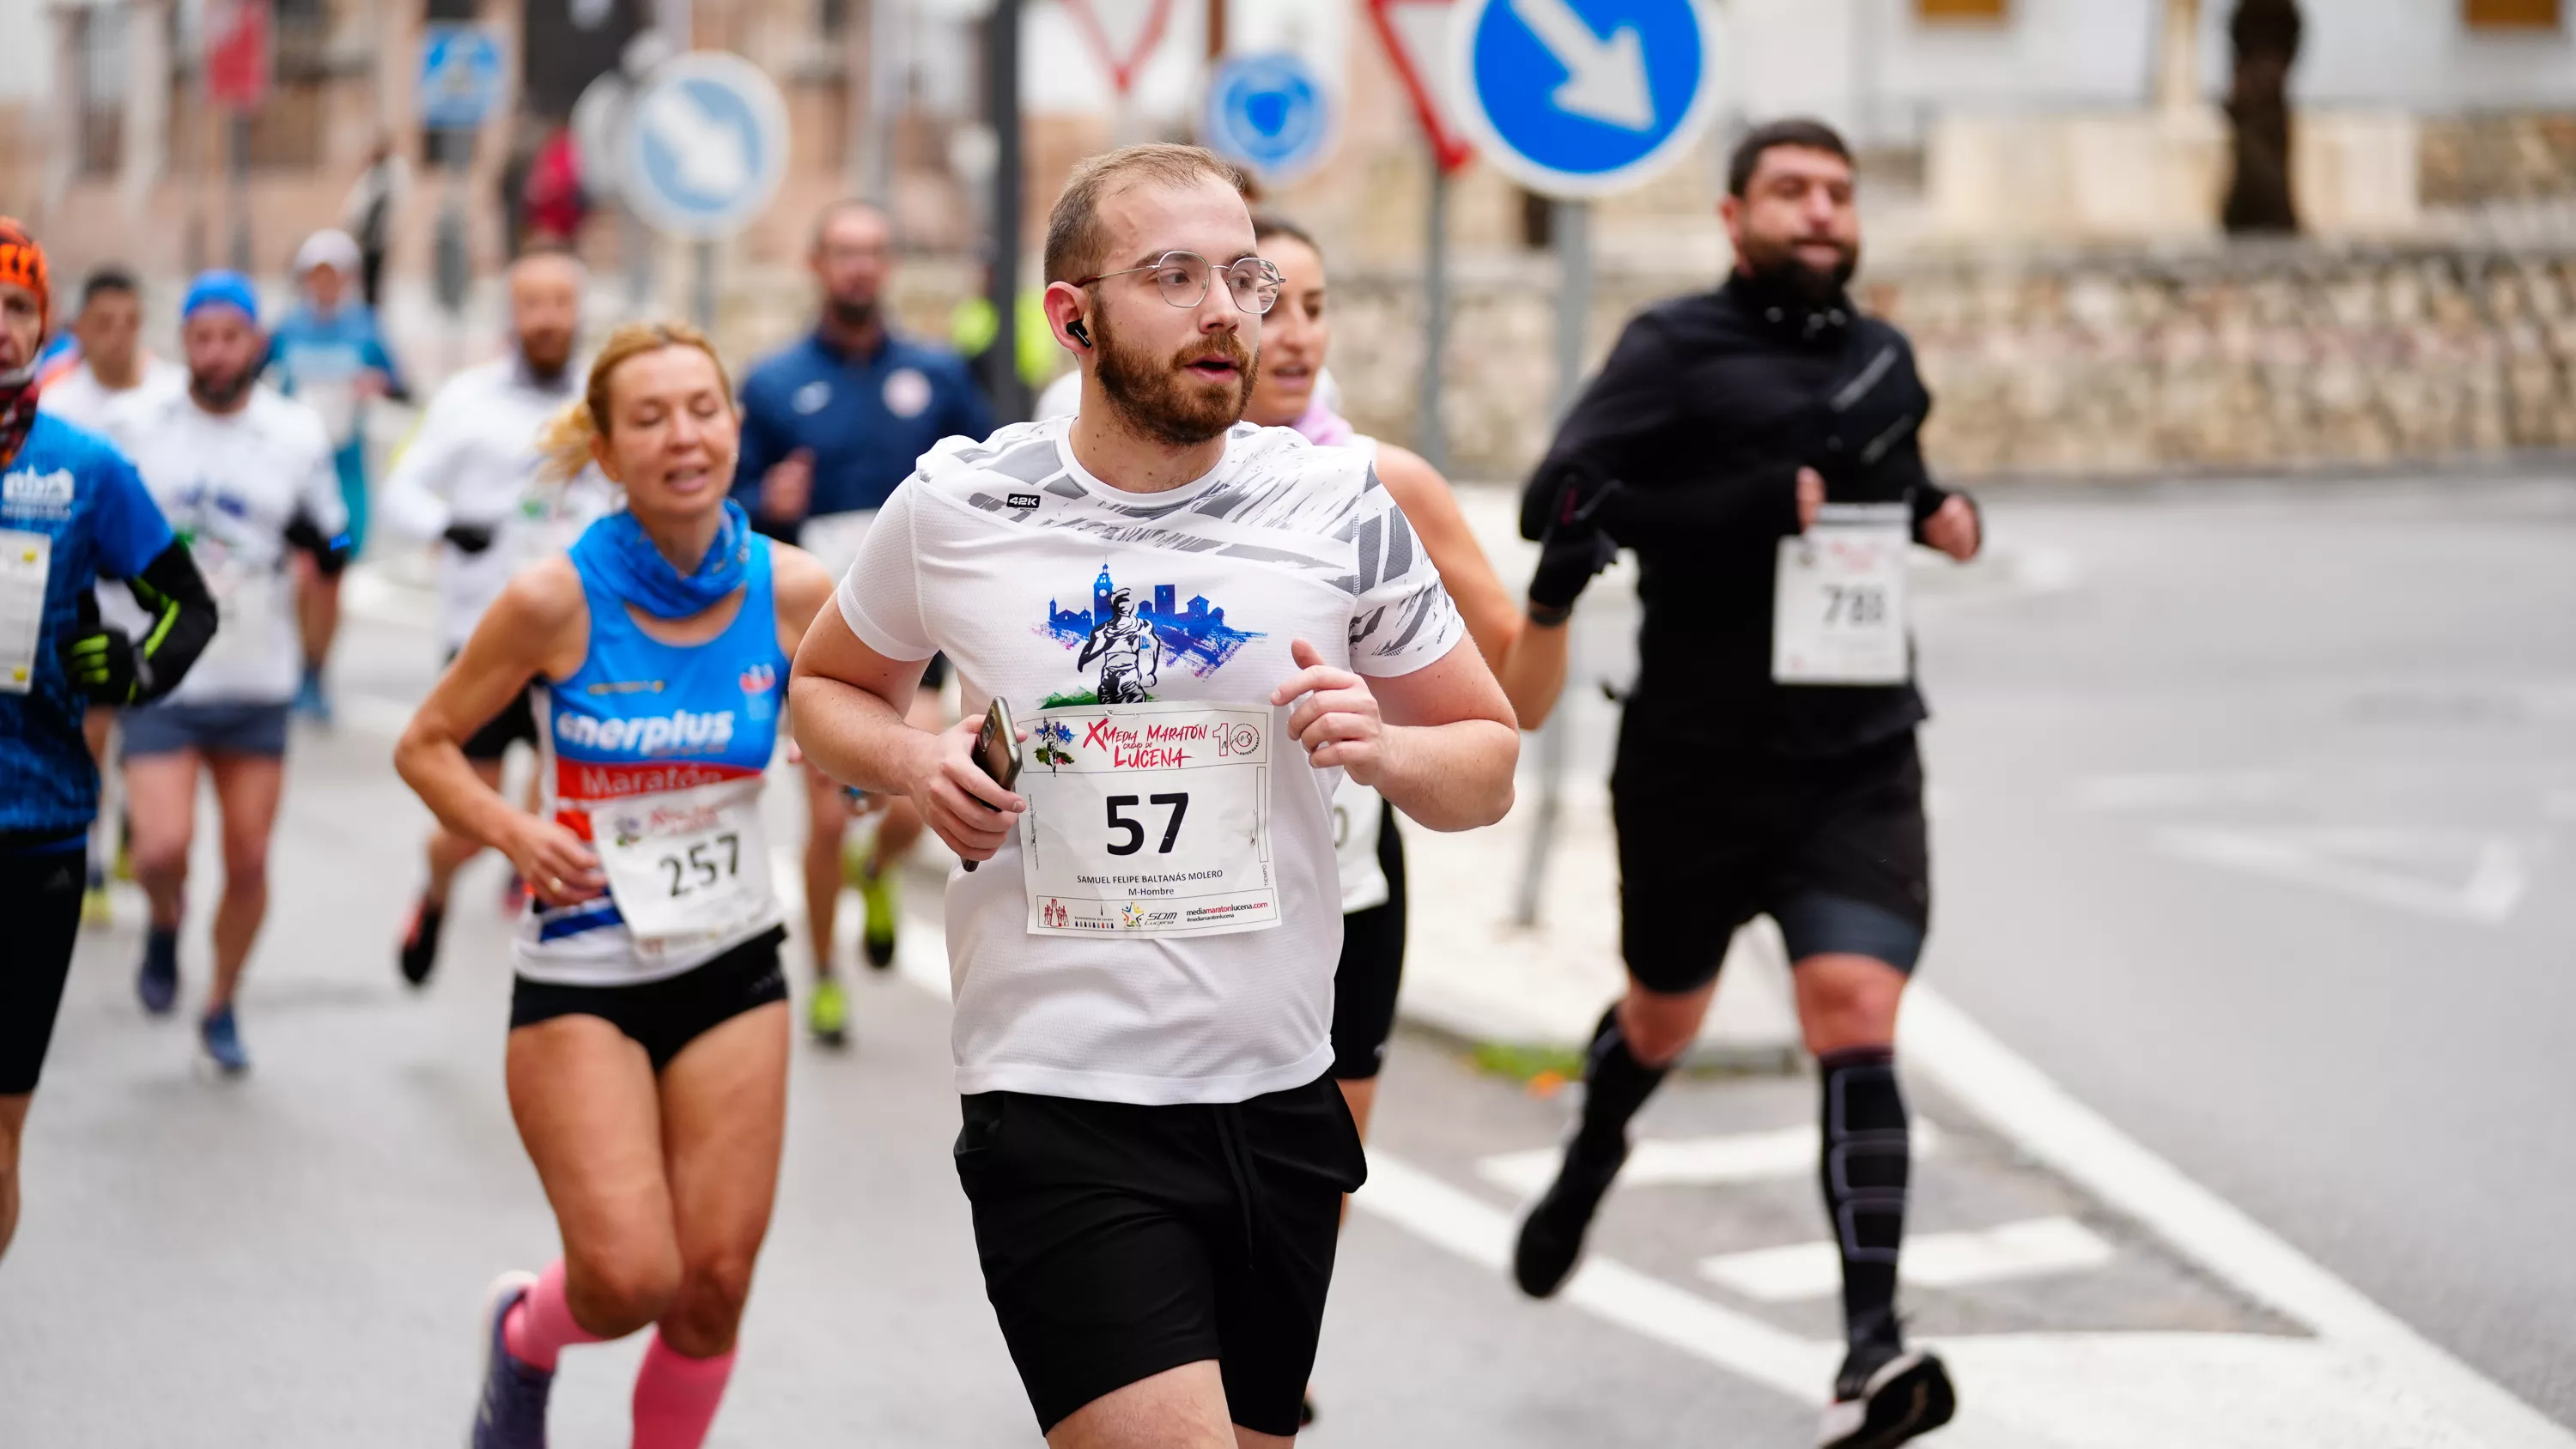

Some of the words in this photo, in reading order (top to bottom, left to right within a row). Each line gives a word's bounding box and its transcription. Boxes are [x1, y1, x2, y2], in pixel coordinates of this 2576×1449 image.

[1008, 496, 1037, 506] 42K
[557, 708, 735, 757] enerplus
[1146, 724, 1208, 745] MARATÓN
[1114, 745, 1194, 769] LUCENA
[580, 761, 723, 797] Maratón
[1106, 791, 1189, 856] 57
[659, 832, 740, 898] 257
[1077, 875, 1111, 884] SAMUEL
[1113, 875, 1140, 884] FELIPE
[1141, 872, 1187, 883] BALTANÁS
[1188, 870, 1224, 881] MOLERO
[1128, 887, 1175, 896] M-Hombre
[1186, 902, 1268, 916] mediamaratonlucena.com
